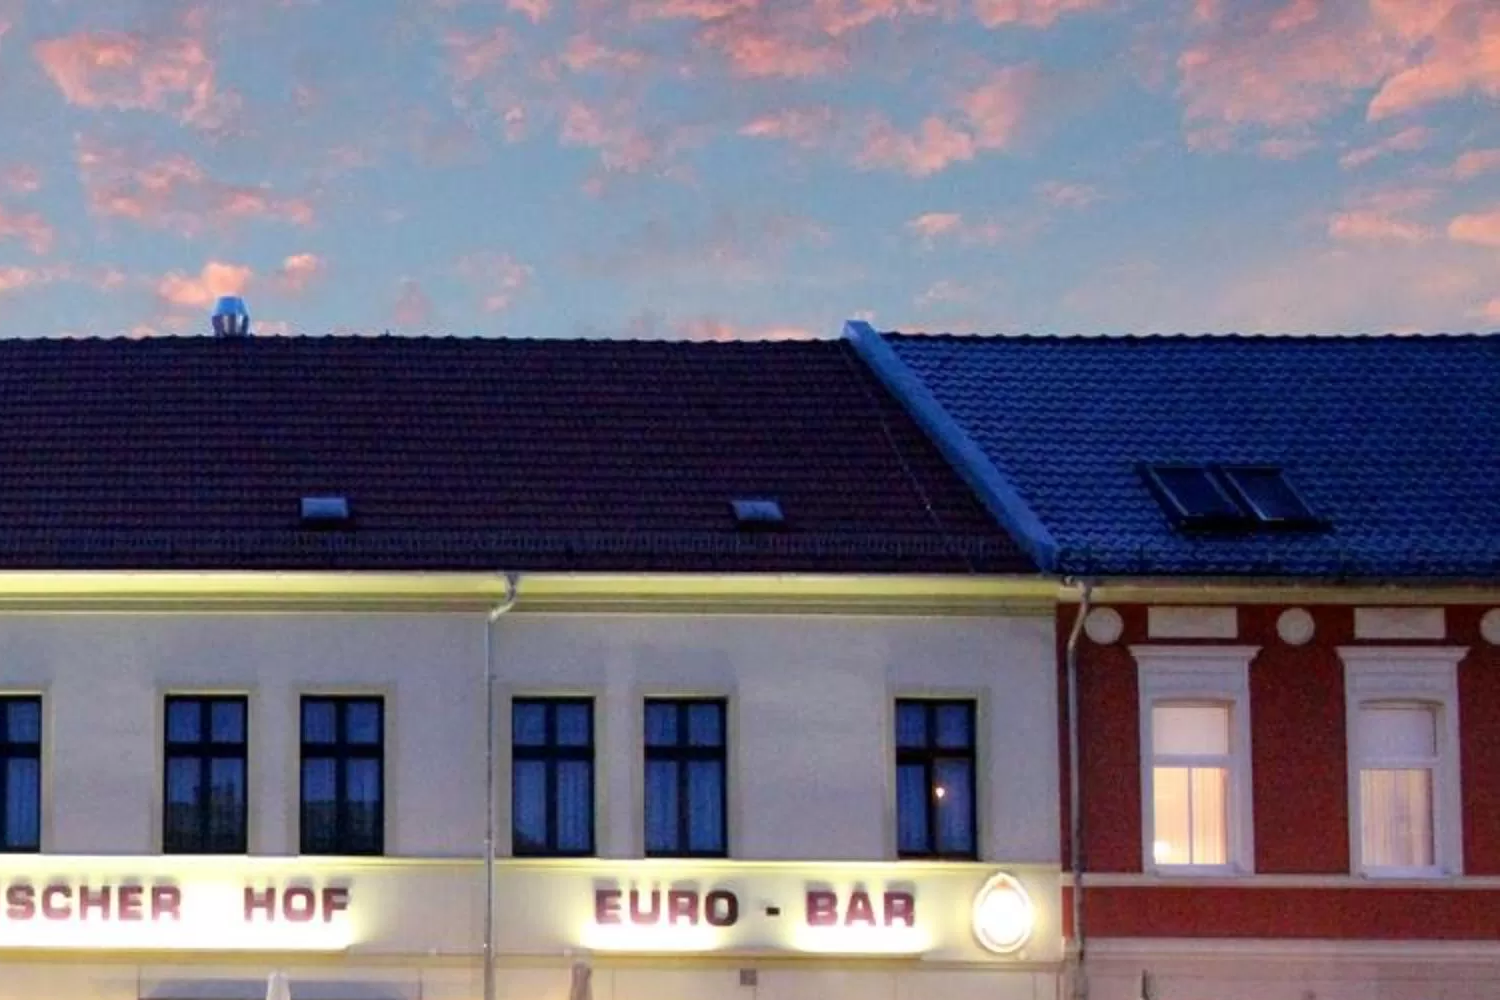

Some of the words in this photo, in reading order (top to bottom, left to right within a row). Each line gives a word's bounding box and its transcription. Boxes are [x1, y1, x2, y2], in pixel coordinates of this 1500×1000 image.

[243, 885, 350, 923] HOF
[594, 888, 740, 928] EURO
[805, 889, 916, 929] BAR
